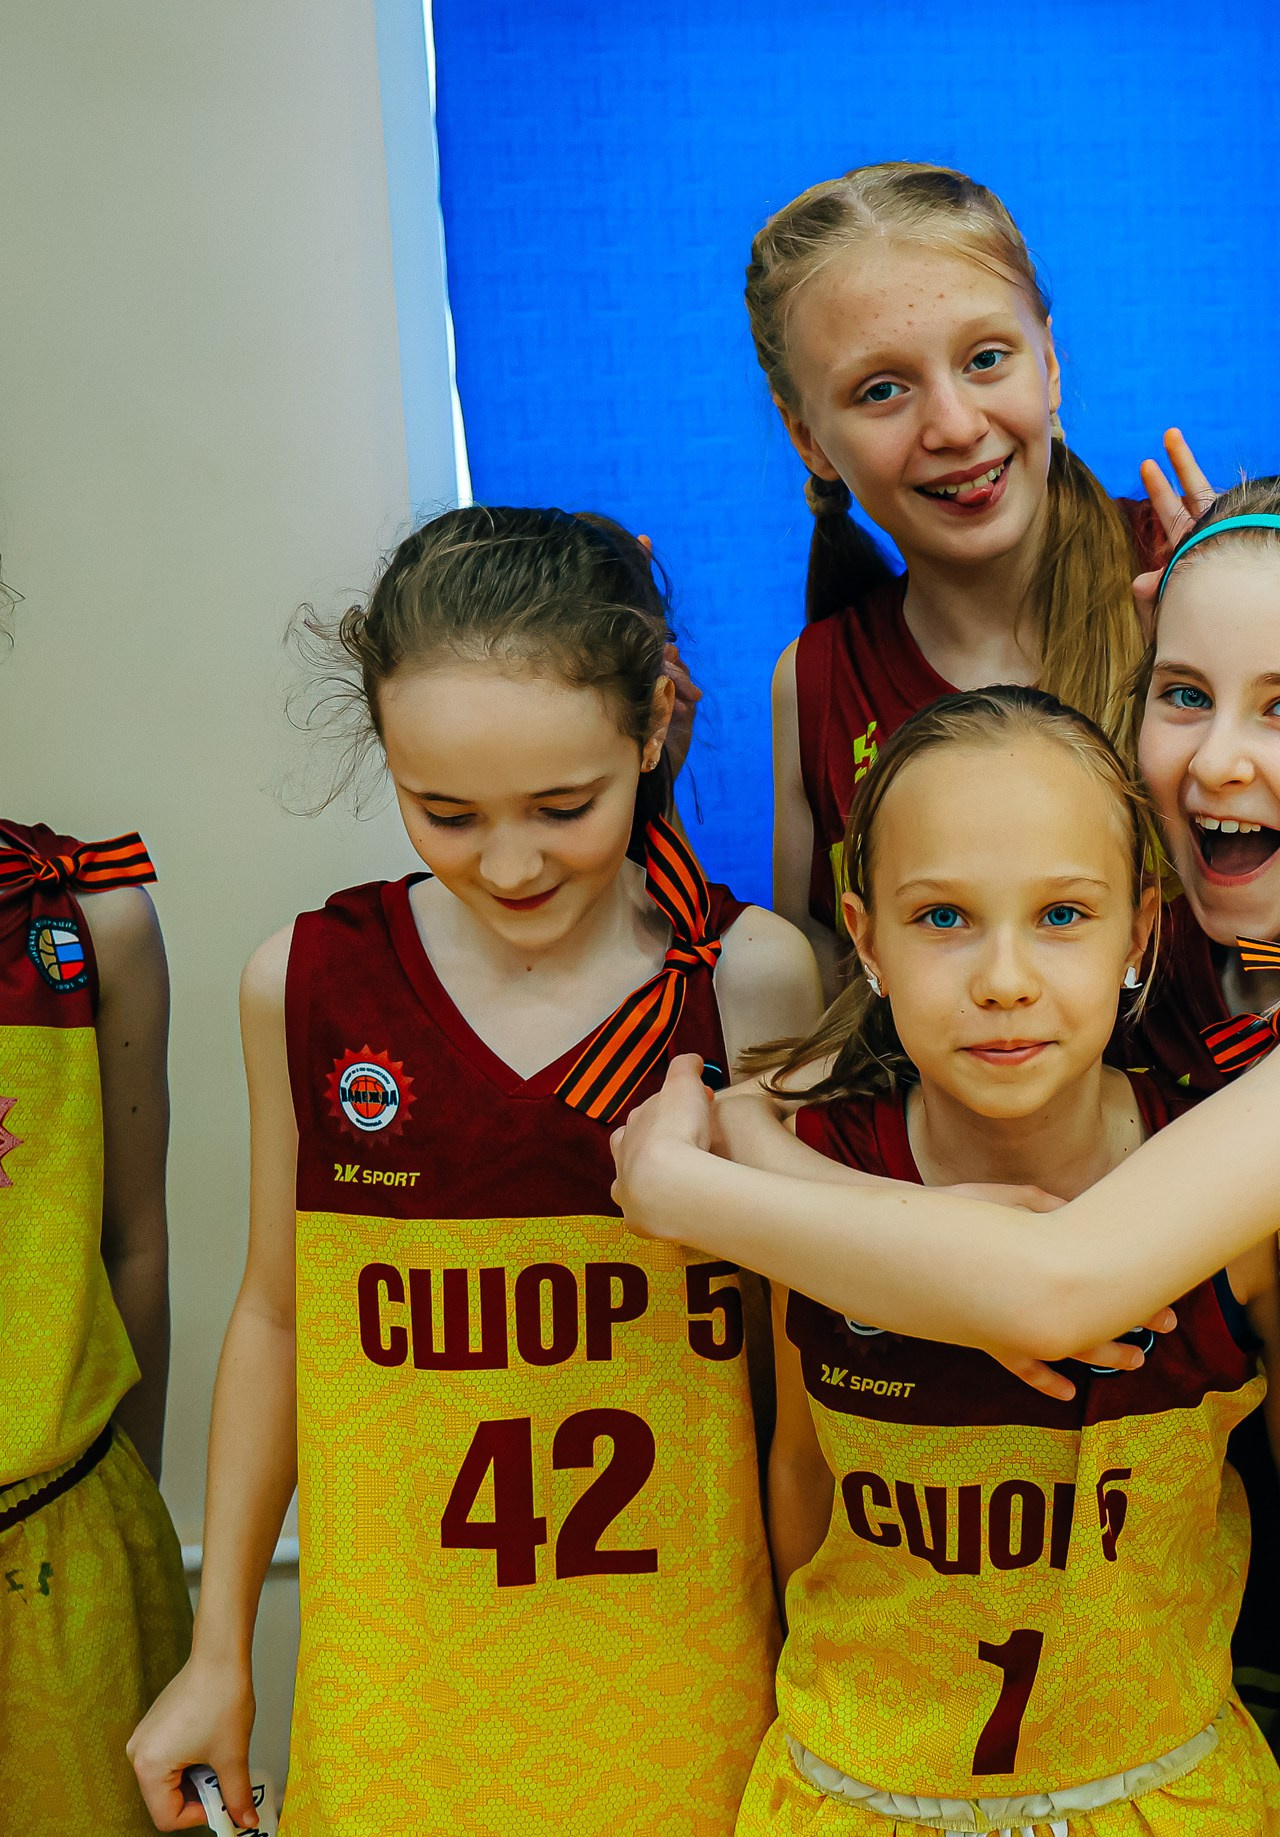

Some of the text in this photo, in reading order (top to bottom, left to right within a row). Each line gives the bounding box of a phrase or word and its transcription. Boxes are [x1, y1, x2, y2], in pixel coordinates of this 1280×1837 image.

[362, 1169, 421, 1187] SPORT
[358, 1260, 745, 1371] СШОР 5
[850, 1376, 916, 1398] SPORT
[441, 1407, 659, 1588] 42
[972, 1628, 1044, 1776] 1
